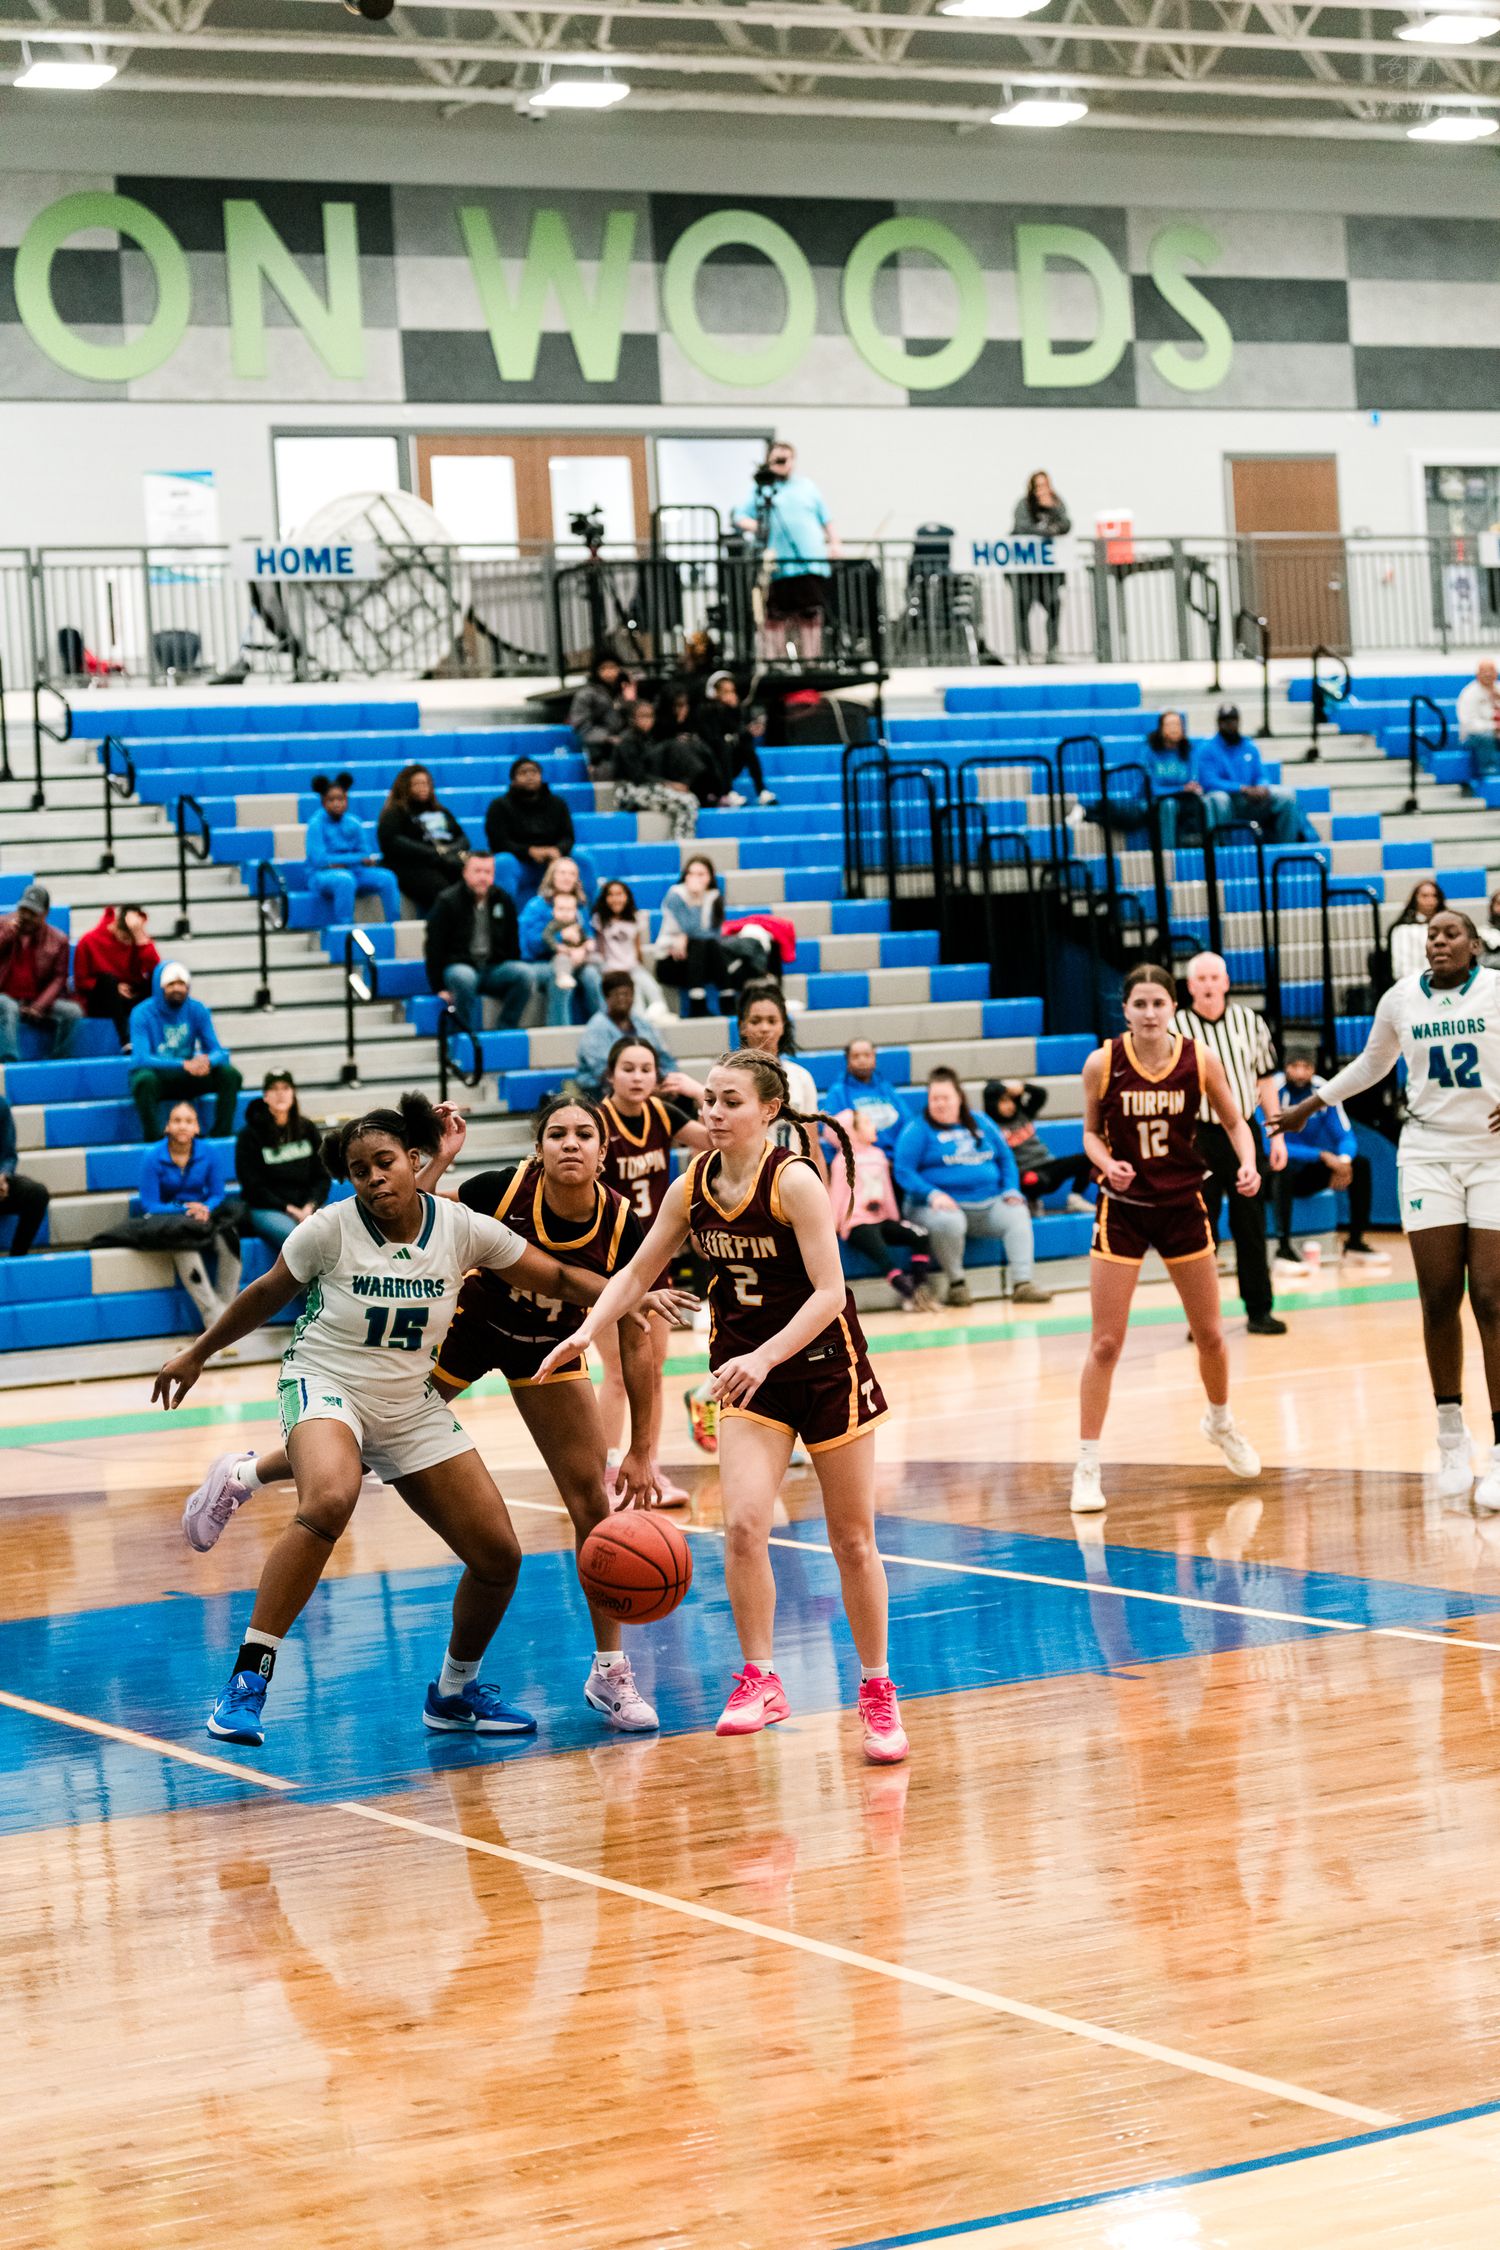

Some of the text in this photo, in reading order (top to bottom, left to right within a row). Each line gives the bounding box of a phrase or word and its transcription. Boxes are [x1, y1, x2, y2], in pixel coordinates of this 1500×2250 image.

[14, 191, 1234, 393] ON WOODS
[256, 546, 354, 575] HOME
[973, 541, 1055, 566] HOME
[1412, 1018, 1486, 1040] WARRIORS
[1428, 1042, 1482, 1089] 42
[1120, 1090, 1185, 1117] TURPIN
[1136, 1119, 1170, 1160] 12
[632, 1179, 653, 1218] 3
[352, 1275, 445, 1298] WARRIORS
[724, 1264, 764, 1307] 2
[364, 1306, 429, 1352] 15
